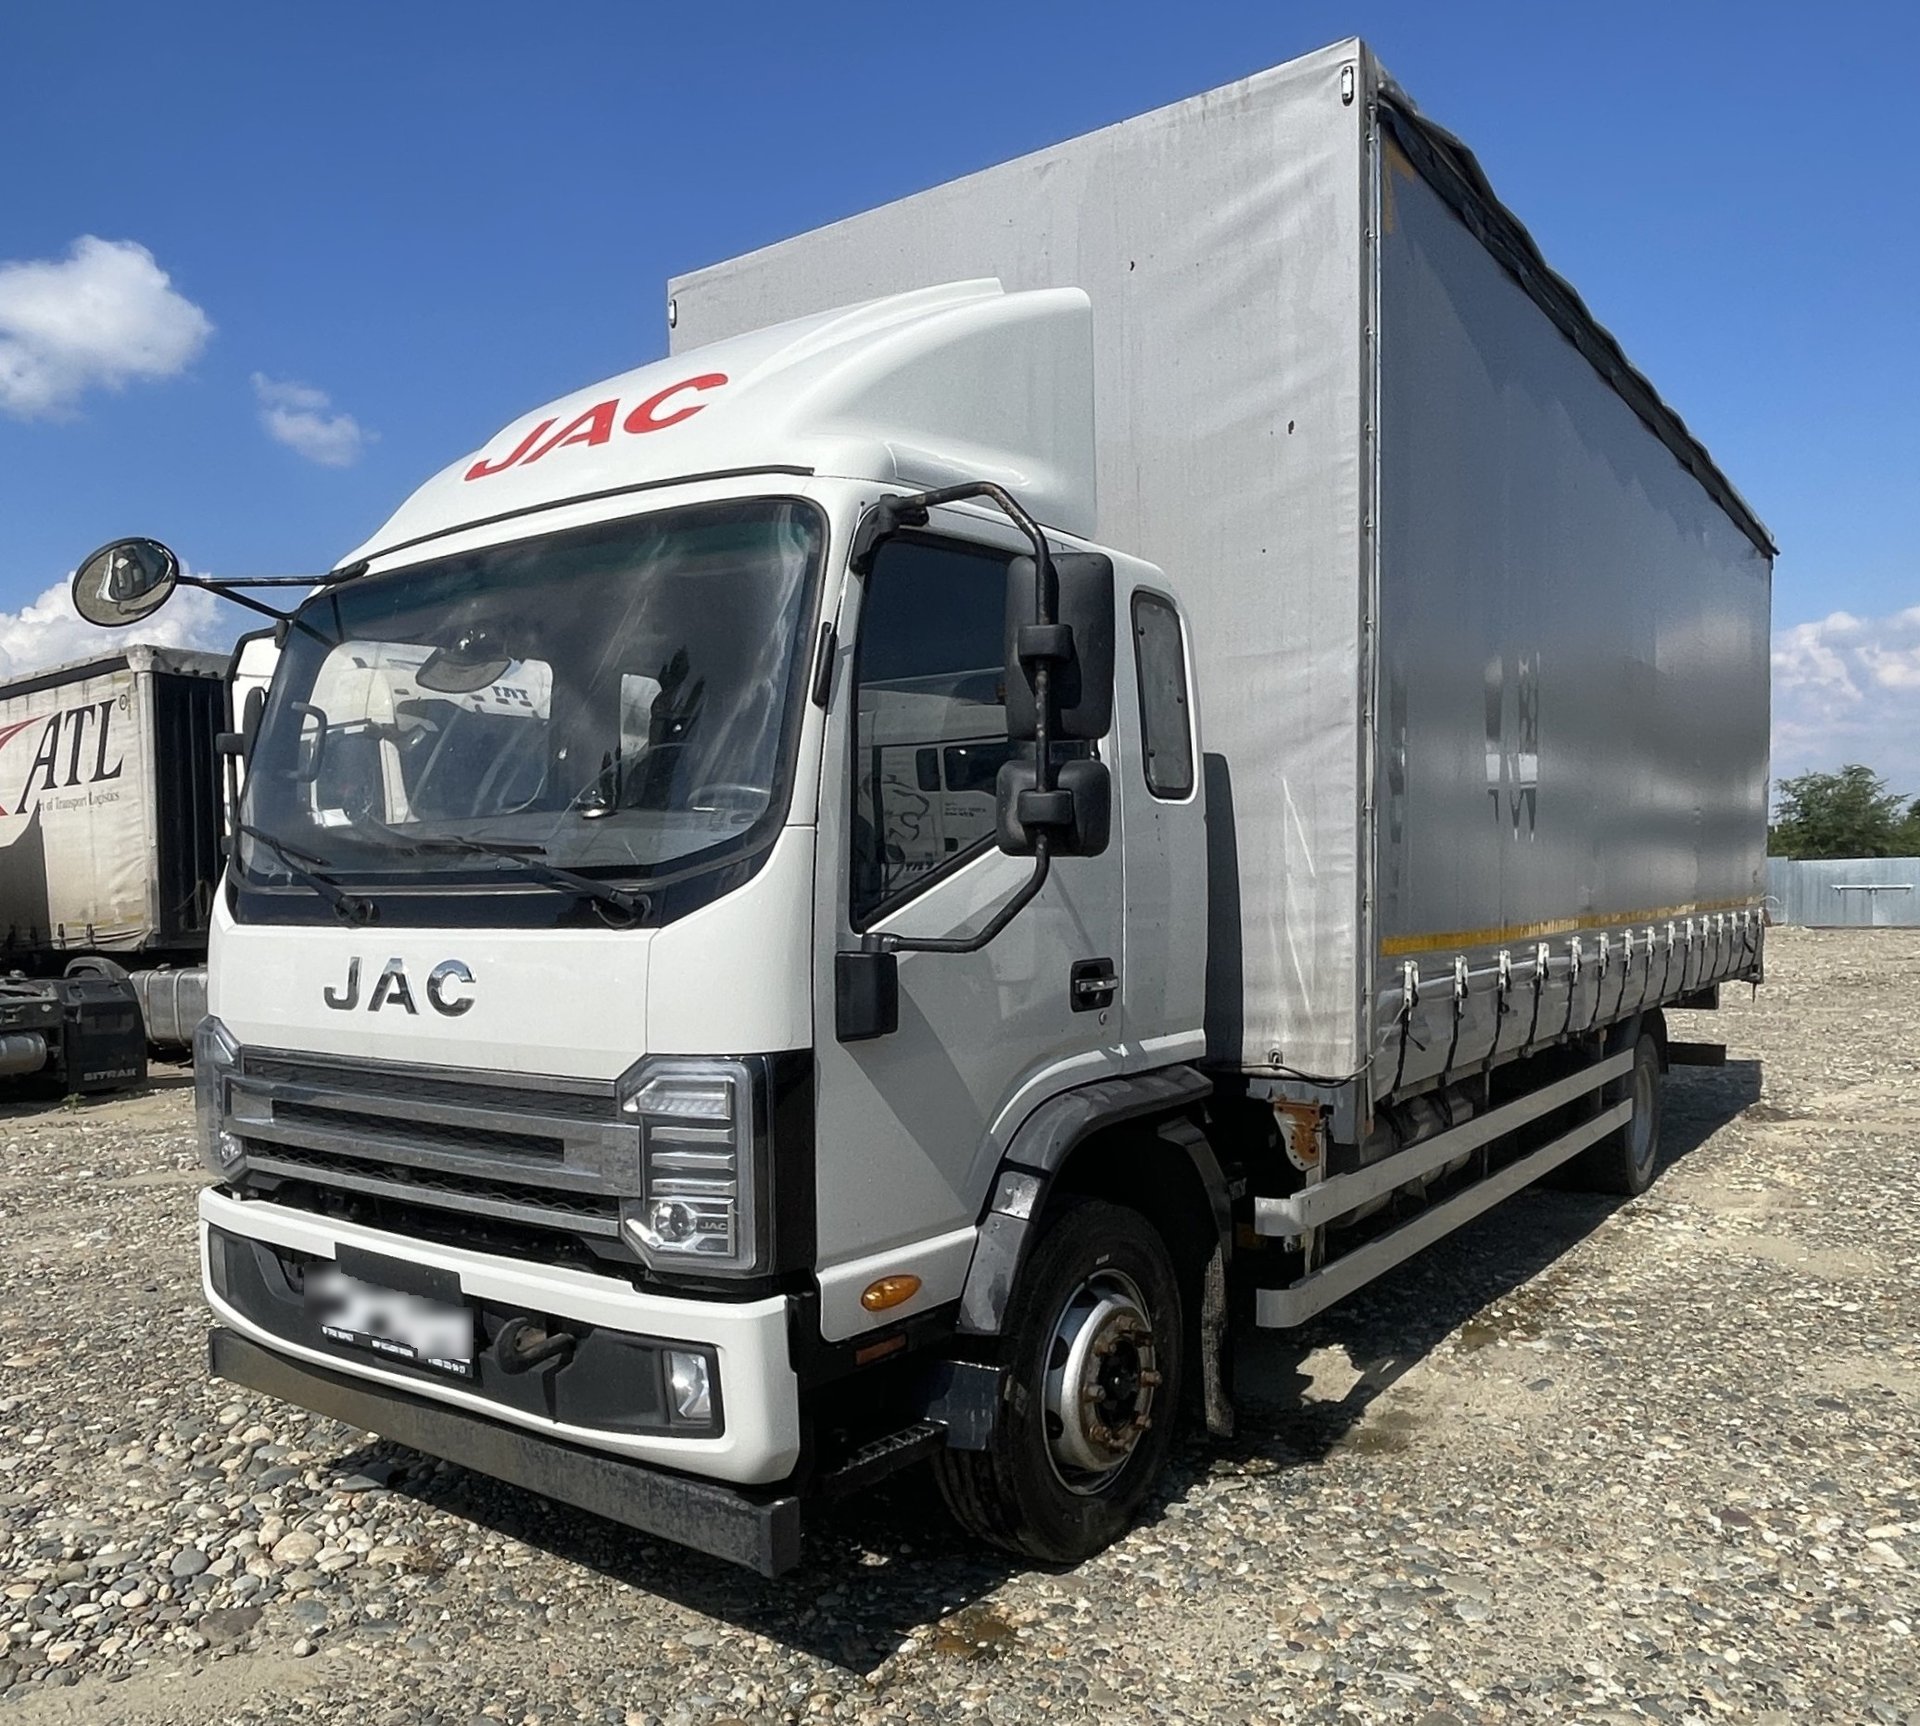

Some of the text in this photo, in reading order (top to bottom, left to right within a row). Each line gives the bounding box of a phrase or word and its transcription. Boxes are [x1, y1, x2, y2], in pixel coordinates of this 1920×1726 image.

[464, 373, 729, 482] JAC
[15, 698, 124, 814] ATL
[55, 796, 87, 812] Transport
[89, 790, 120, 808] Logistics
[324, 957, 477, 1017] JAC
[700, 1221, 728, 1231] JAC
